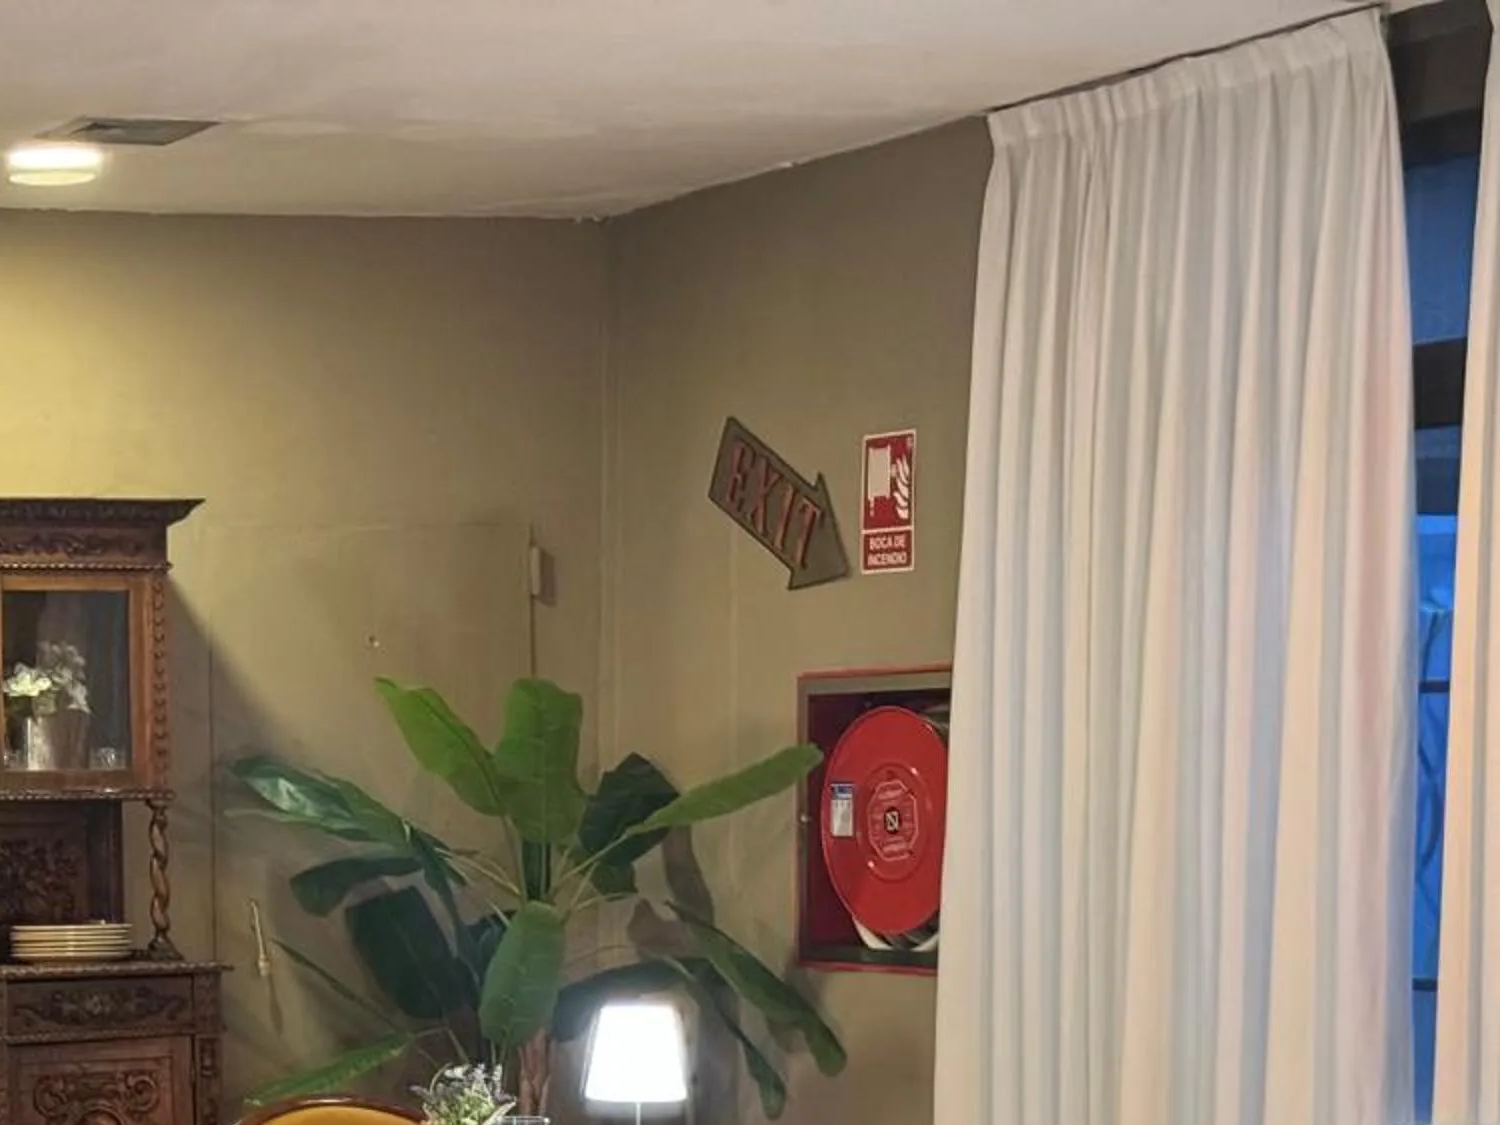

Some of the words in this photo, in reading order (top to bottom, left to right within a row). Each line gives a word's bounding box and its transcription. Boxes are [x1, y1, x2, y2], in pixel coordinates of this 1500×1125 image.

[725, 438, 825, 570] EXIT
[869, 535, 893, 550] BOCA
[893, 534, 906, 548] DE
[867, 551, 907, 566] INCENDIO
